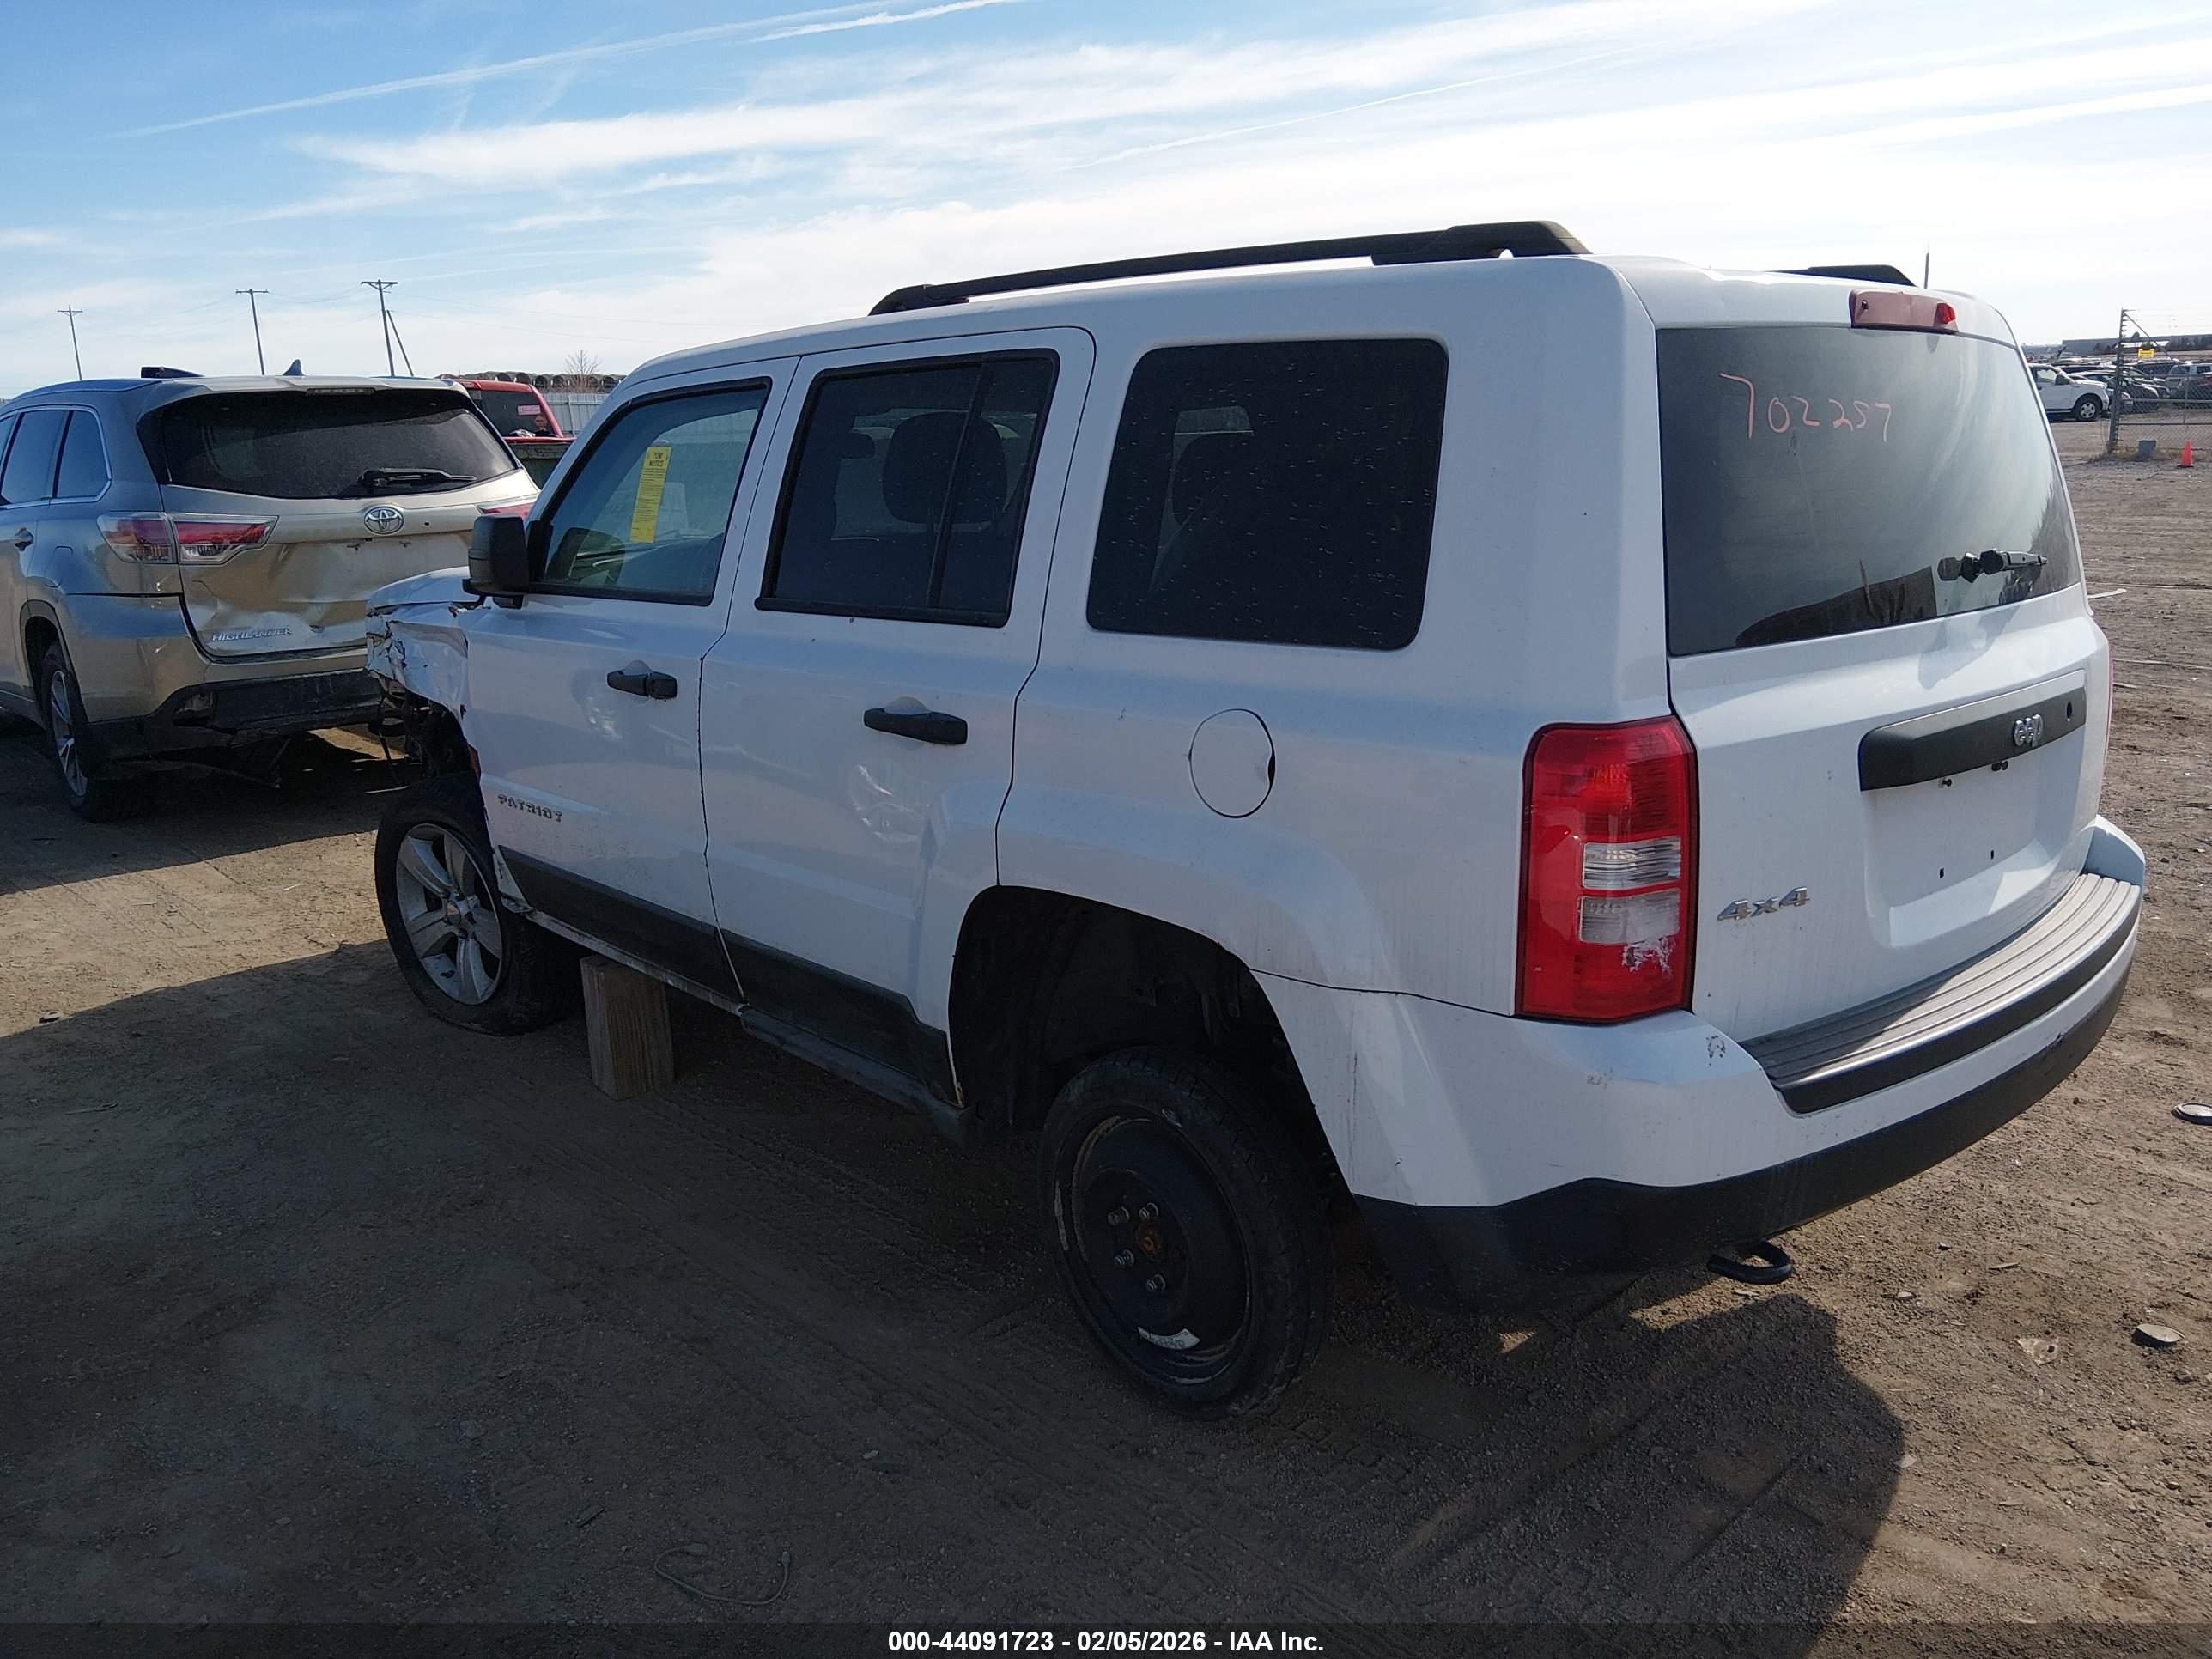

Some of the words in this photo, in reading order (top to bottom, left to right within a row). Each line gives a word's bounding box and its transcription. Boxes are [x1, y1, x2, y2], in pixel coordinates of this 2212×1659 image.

[1718, 371, 1893, 443] 702257
[211, 626, 293, 642] HIGHLANDER
[497, 793, 563, 823] PATRIOT
